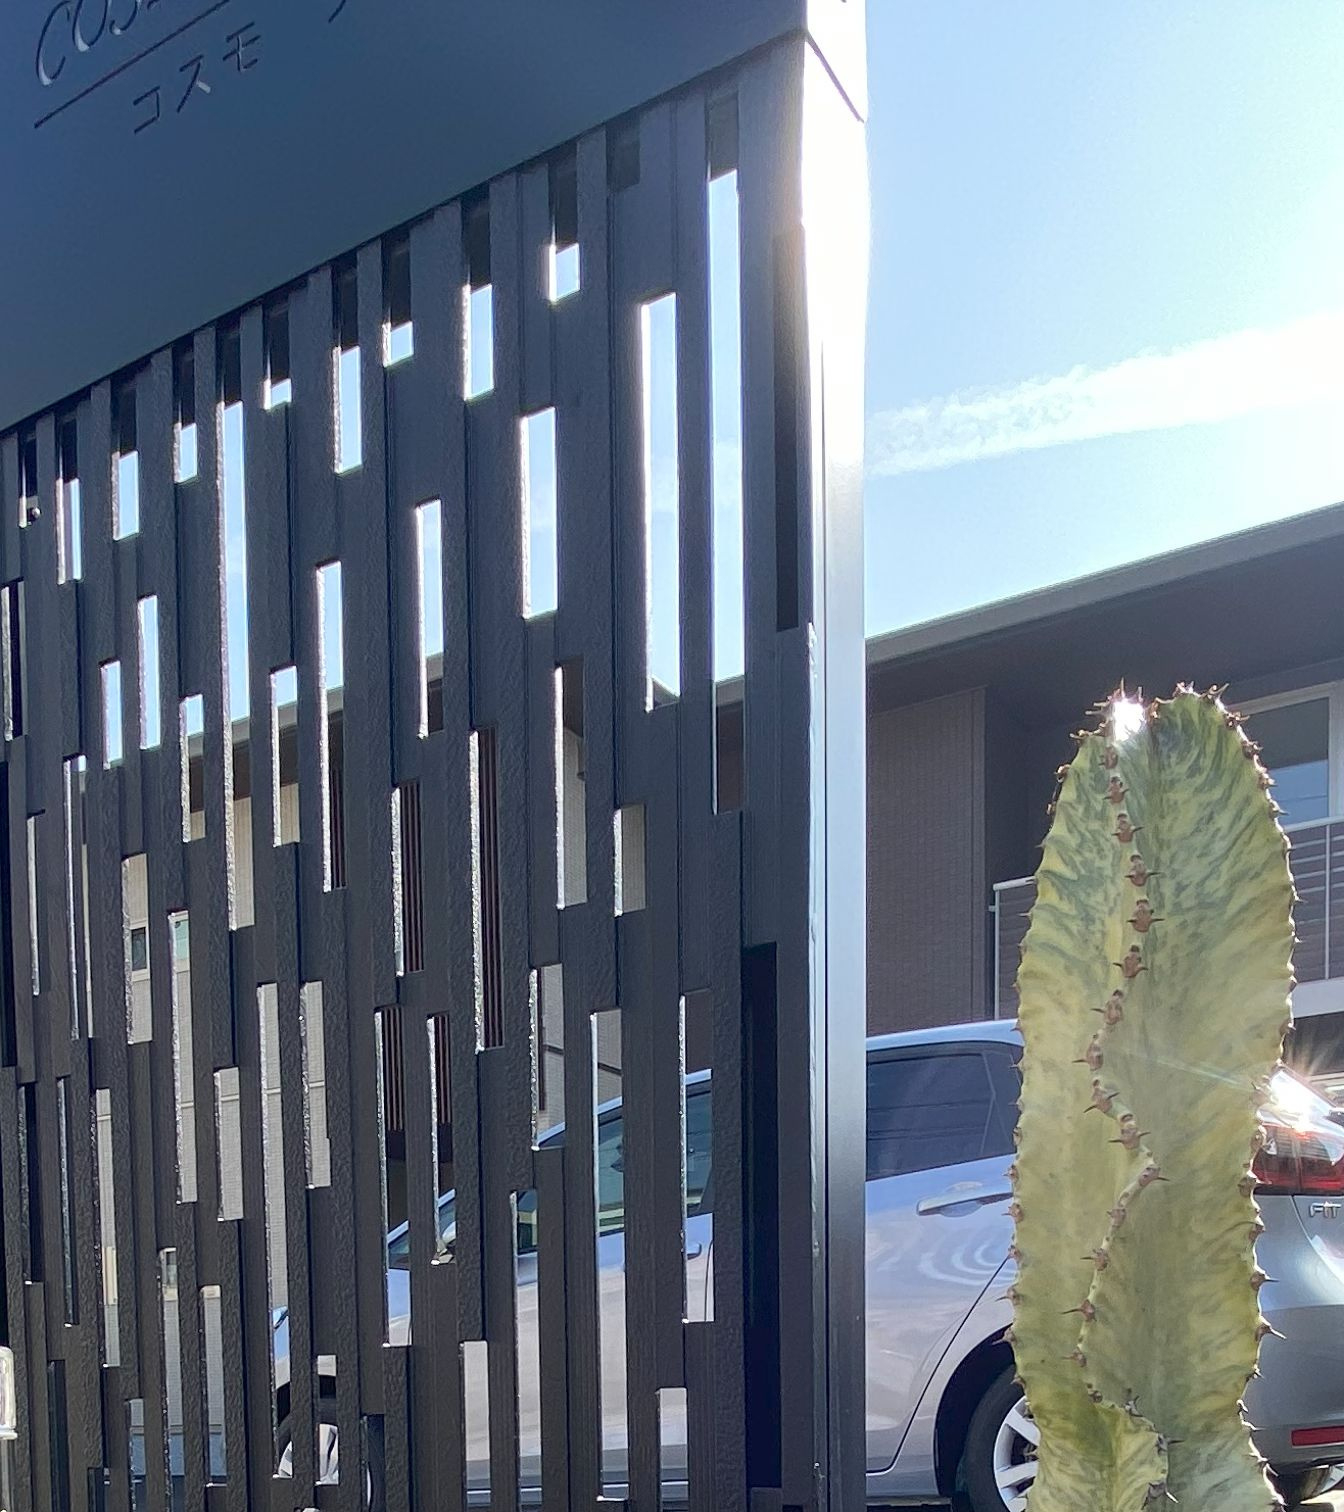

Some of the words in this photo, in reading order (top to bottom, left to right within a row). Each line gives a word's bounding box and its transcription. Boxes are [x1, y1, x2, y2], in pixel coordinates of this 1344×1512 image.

[132, 21, 262, 135] コスモ
[1309, 1201, 1342, 1219] FIT
